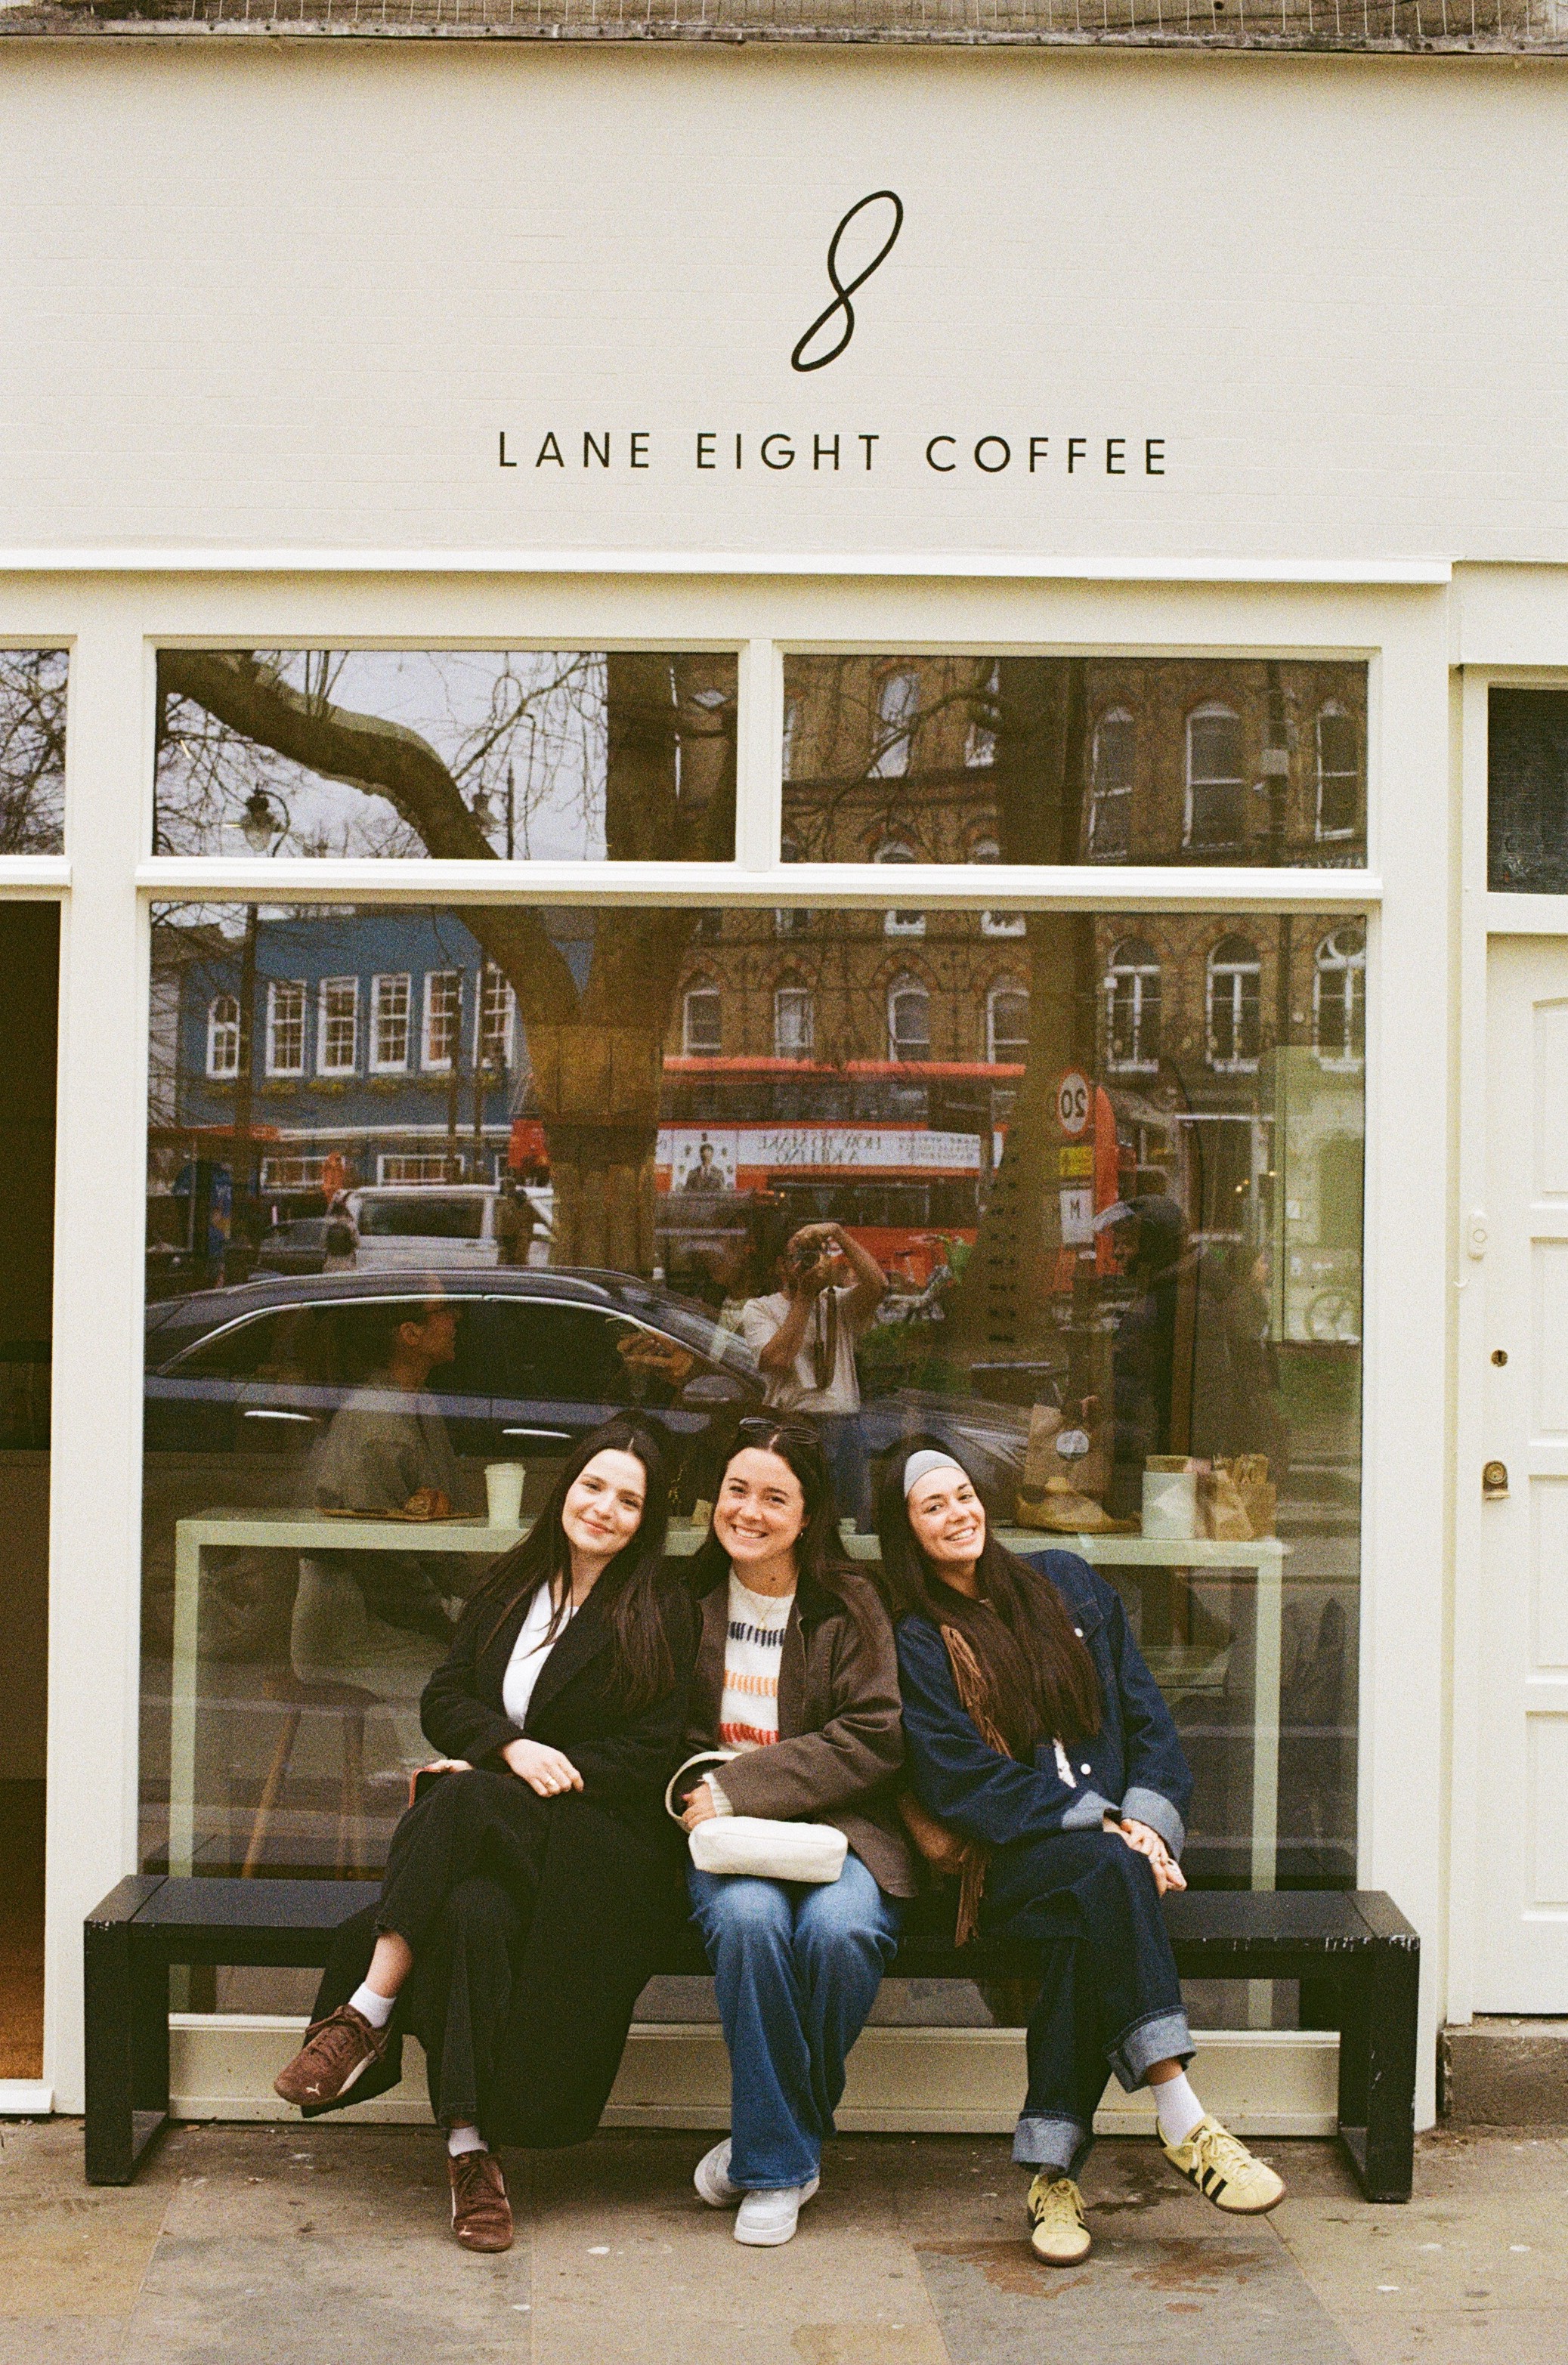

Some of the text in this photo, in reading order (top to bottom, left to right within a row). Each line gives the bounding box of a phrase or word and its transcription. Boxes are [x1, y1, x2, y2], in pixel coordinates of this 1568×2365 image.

[790, 190, 904, 373] 8
[499, 431, 1165, 475] LANE EIGHT COFFEE
